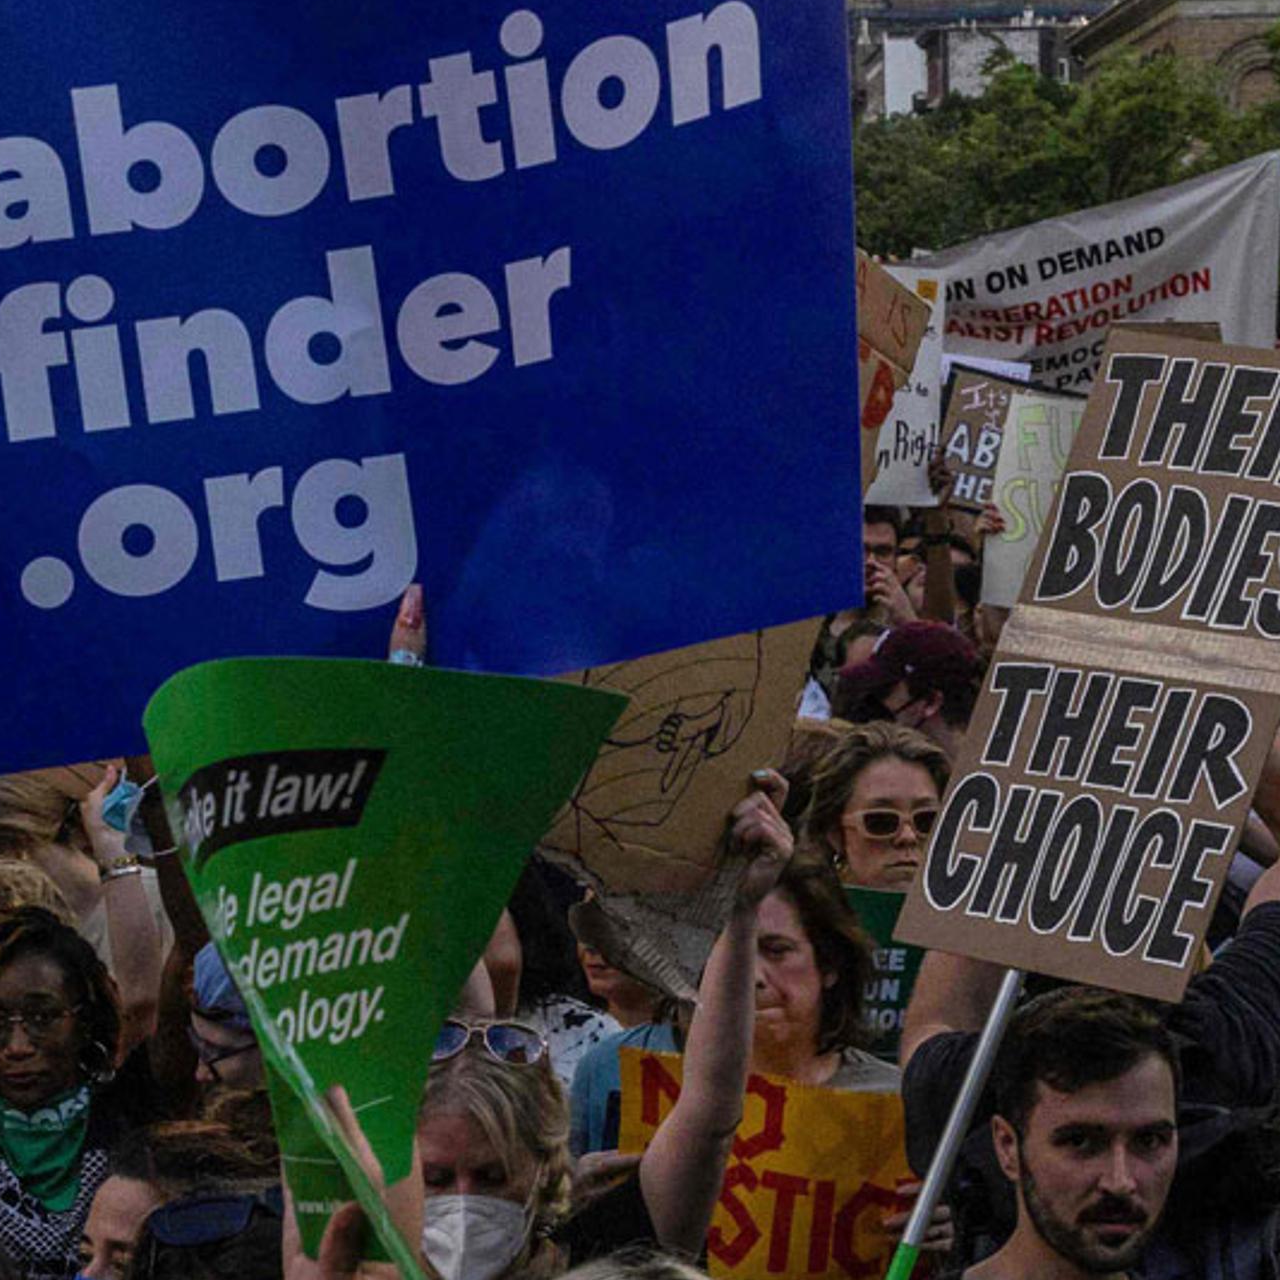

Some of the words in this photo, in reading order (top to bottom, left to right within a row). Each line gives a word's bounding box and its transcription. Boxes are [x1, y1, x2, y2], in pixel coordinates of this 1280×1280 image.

[986, 264, 1027, 294] ON
[1038, 227, 1164, 281] DEMAND
[1035, 268, 1211, 346] REVOLUTION
[20, 453, 418, 612] .org
[981, 662, 1253, 810] THEIR
[222, 769, 252, 828] it
[255, 760, 368, 819] law!
[246, 857, 359, 931] legal
[924, 772, 1232, 968] CHOICE
[238, 913, 410, 990] demand
